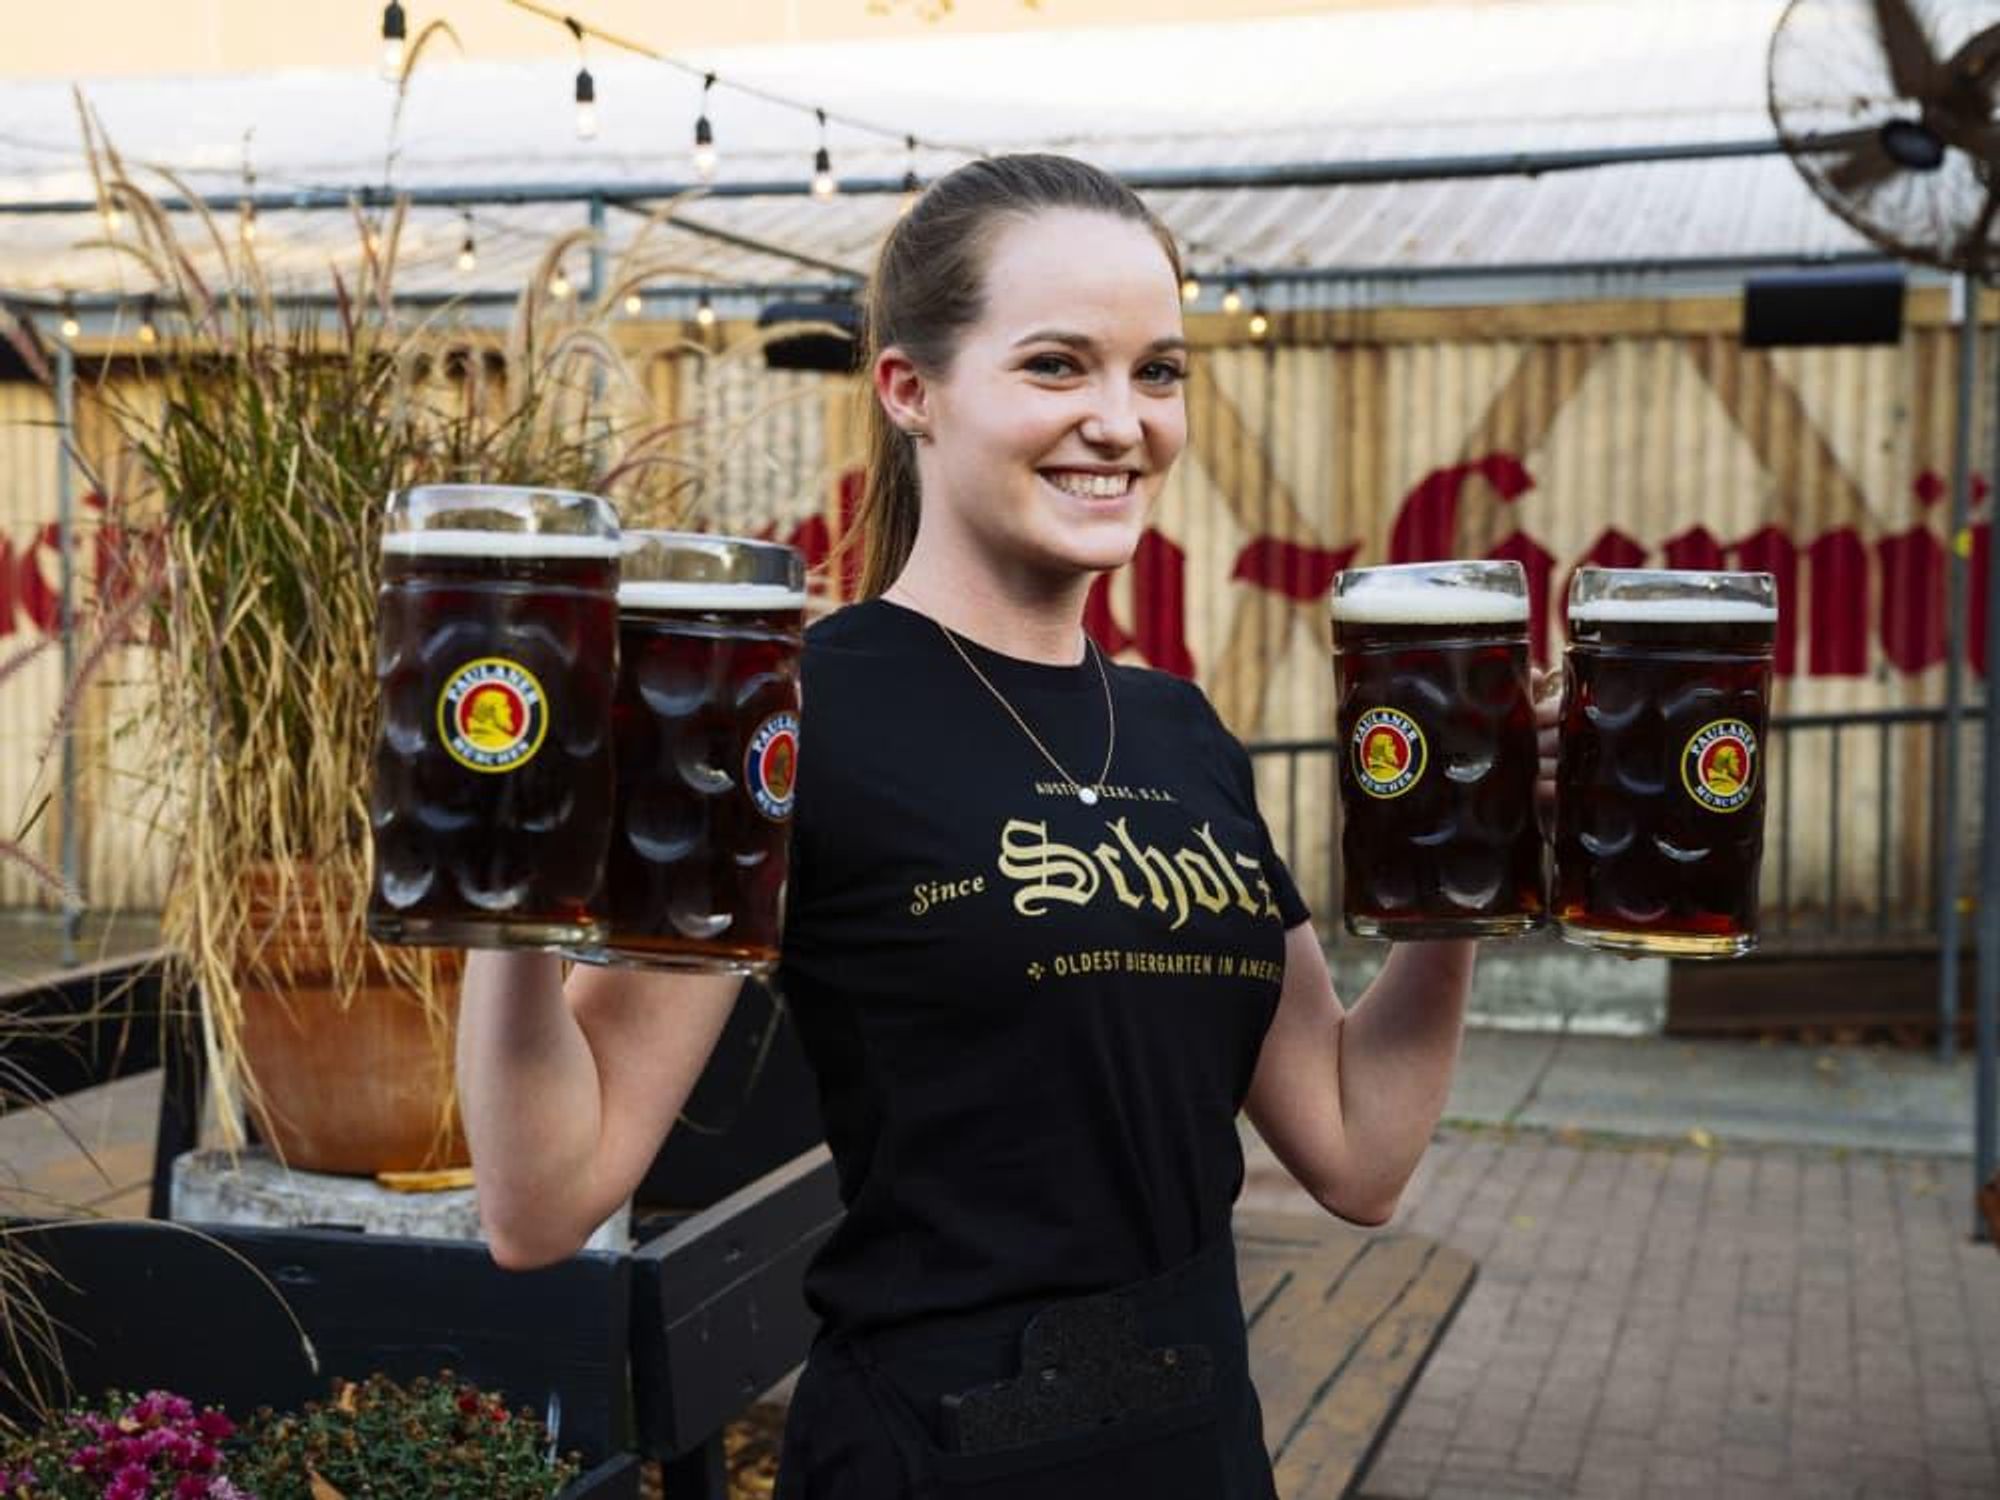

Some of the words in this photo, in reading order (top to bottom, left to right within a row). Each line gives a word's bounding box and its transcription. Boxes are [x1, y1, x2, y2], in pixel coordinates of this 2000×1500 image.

[447, 664, 538, 705] PAULANER
[1353, 712, 1418, 744] PAULANER
[1690, 723, 1756, 756] PAULANER
[910, 874, 986, 916] Since
[1054, 951, 1120, 977] OLDEST
[1126, 952, 1212, 977] BIERGARTEN
[1218, 955, 1234, 976] IN
